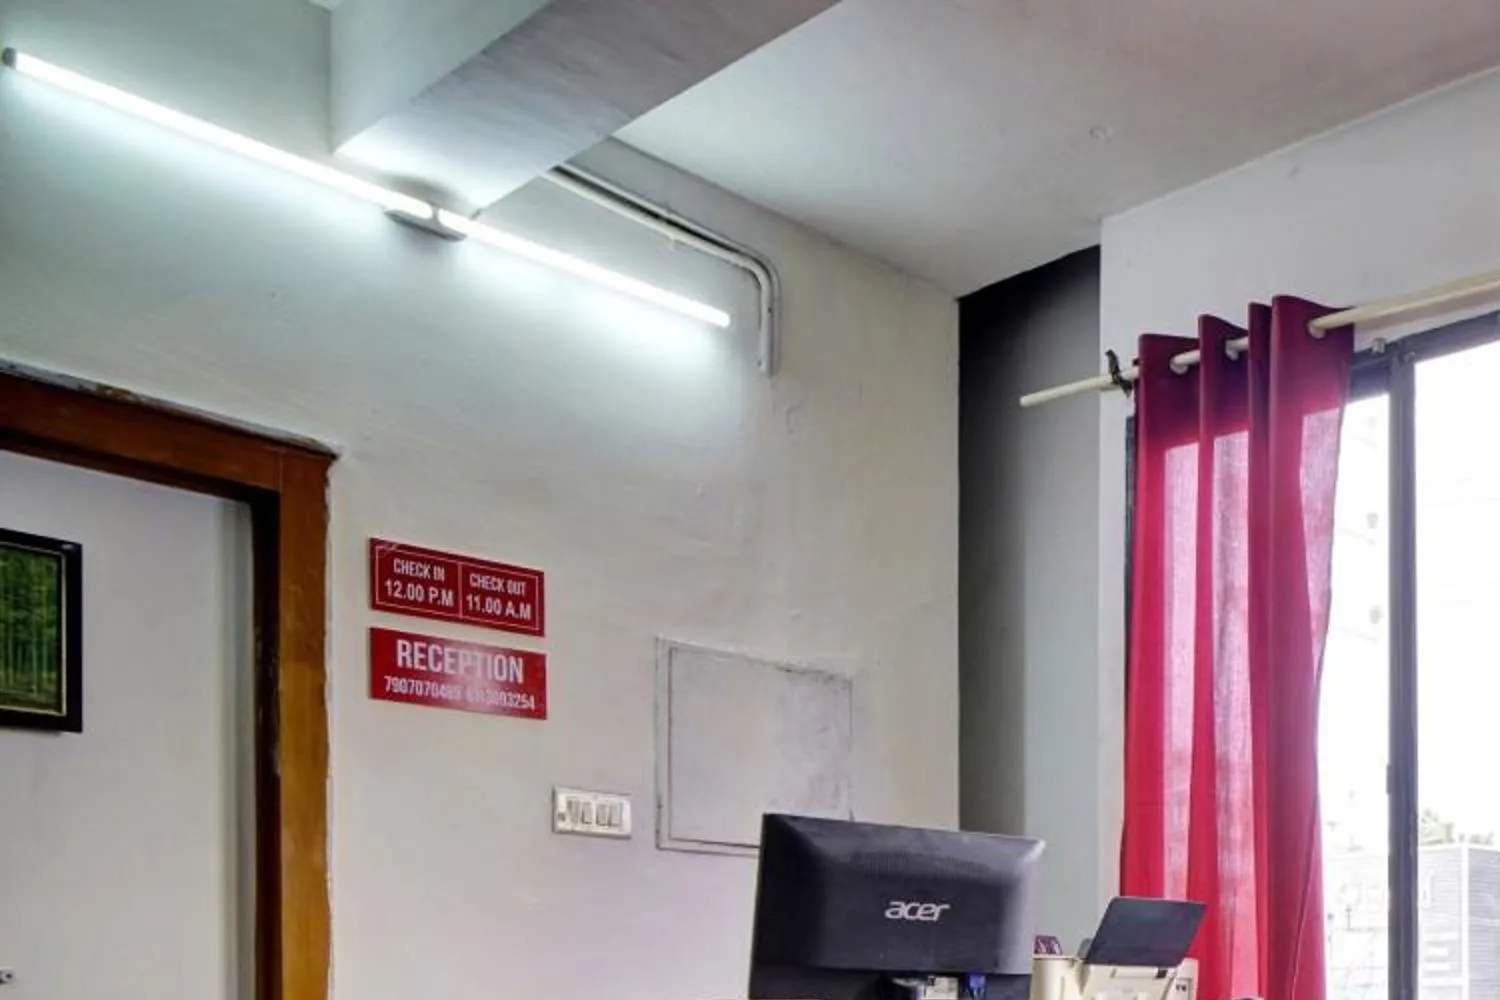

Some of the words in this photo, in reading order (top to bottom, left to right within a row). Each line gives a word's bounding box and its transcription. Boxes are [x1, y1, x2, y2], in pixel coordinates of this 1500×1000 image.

[393, 558, 431, 579] CHECK
[433, 565, 445, 582] IN
[385, 579, 425, 602] 12.00
[428, 586, 454, 607] P.M
[469, 573, 504, 592] CHECK
[507, 580, 527, 596] OUT
[466, 594, 501, 615] 11.00
[505, 600, 532, 620] A.M
[396, 638, 524, 684] RECEPTION
[884, 900, 951, 921] acer
